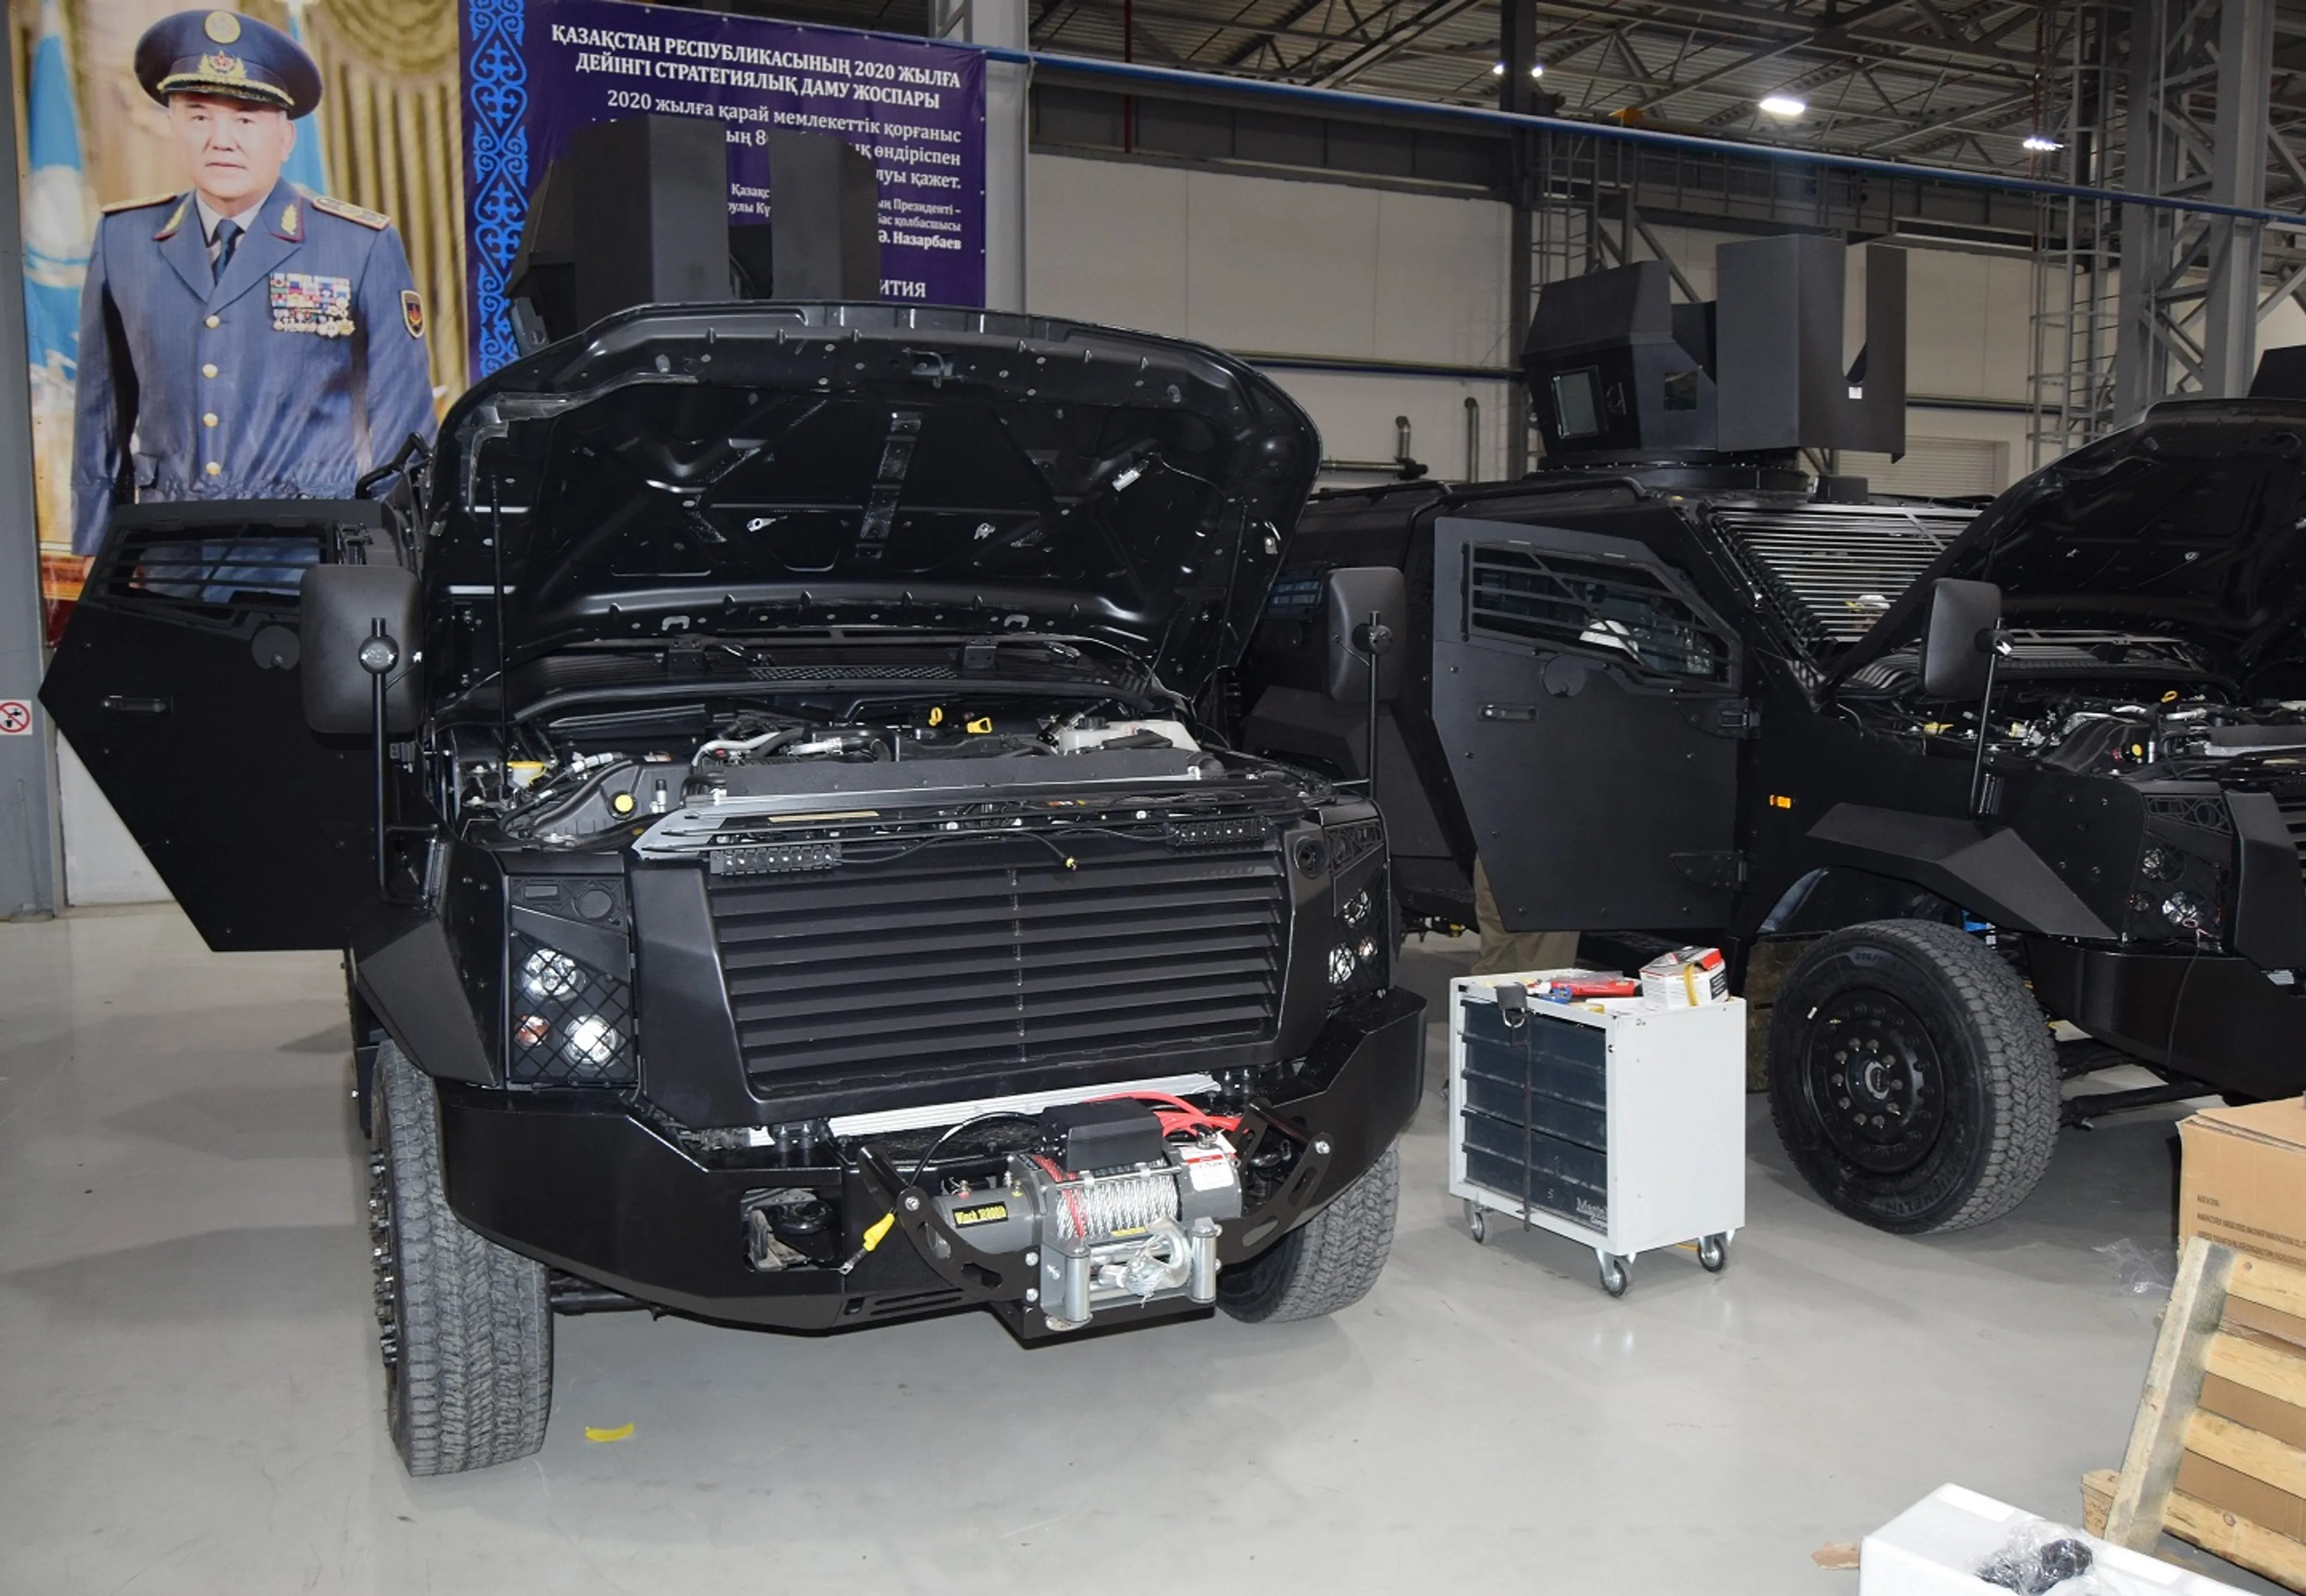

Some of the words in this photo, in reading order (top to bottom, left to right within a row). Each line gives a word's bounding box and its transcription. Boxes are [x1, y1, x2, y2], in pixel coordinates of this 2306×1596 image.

[551, 23, 660, 52] ҚАЗАҚСТАН
[664, 37, 852, 77] РЕСПУБЛИКАСЫНЫҢ
[855, 61, 895, 80] 2020
[898, 66, 960, 88] ЖЫЛҒА
[575, 52, 651, 77] ДЕЙІНГІ
[655, 61, 798, 96] СТРАТЕГИЯЛЫҚ
[800, 78, 850, 98] ДАМУ
[853, 85, 940, 109] ЖОСПАРЫ
[607, 89, 652, 110] 2020
[655, 98, 714, 116] жылға
[718, 104, 769, 124] қарай
[773, 110, 880, 134] мемлекеттік
[883, 122, 962, 143] қорғаныс
[755, 129, 769, 145] 8
[874, 145, 961, 166] өндіріспен
[910, 172, 961, 189] қажет.
[893, 198, 954, 215] Президенті
[894, 216, 961, 232] қолбасшысы
[892, 231, 962, 250] Назарбаев
